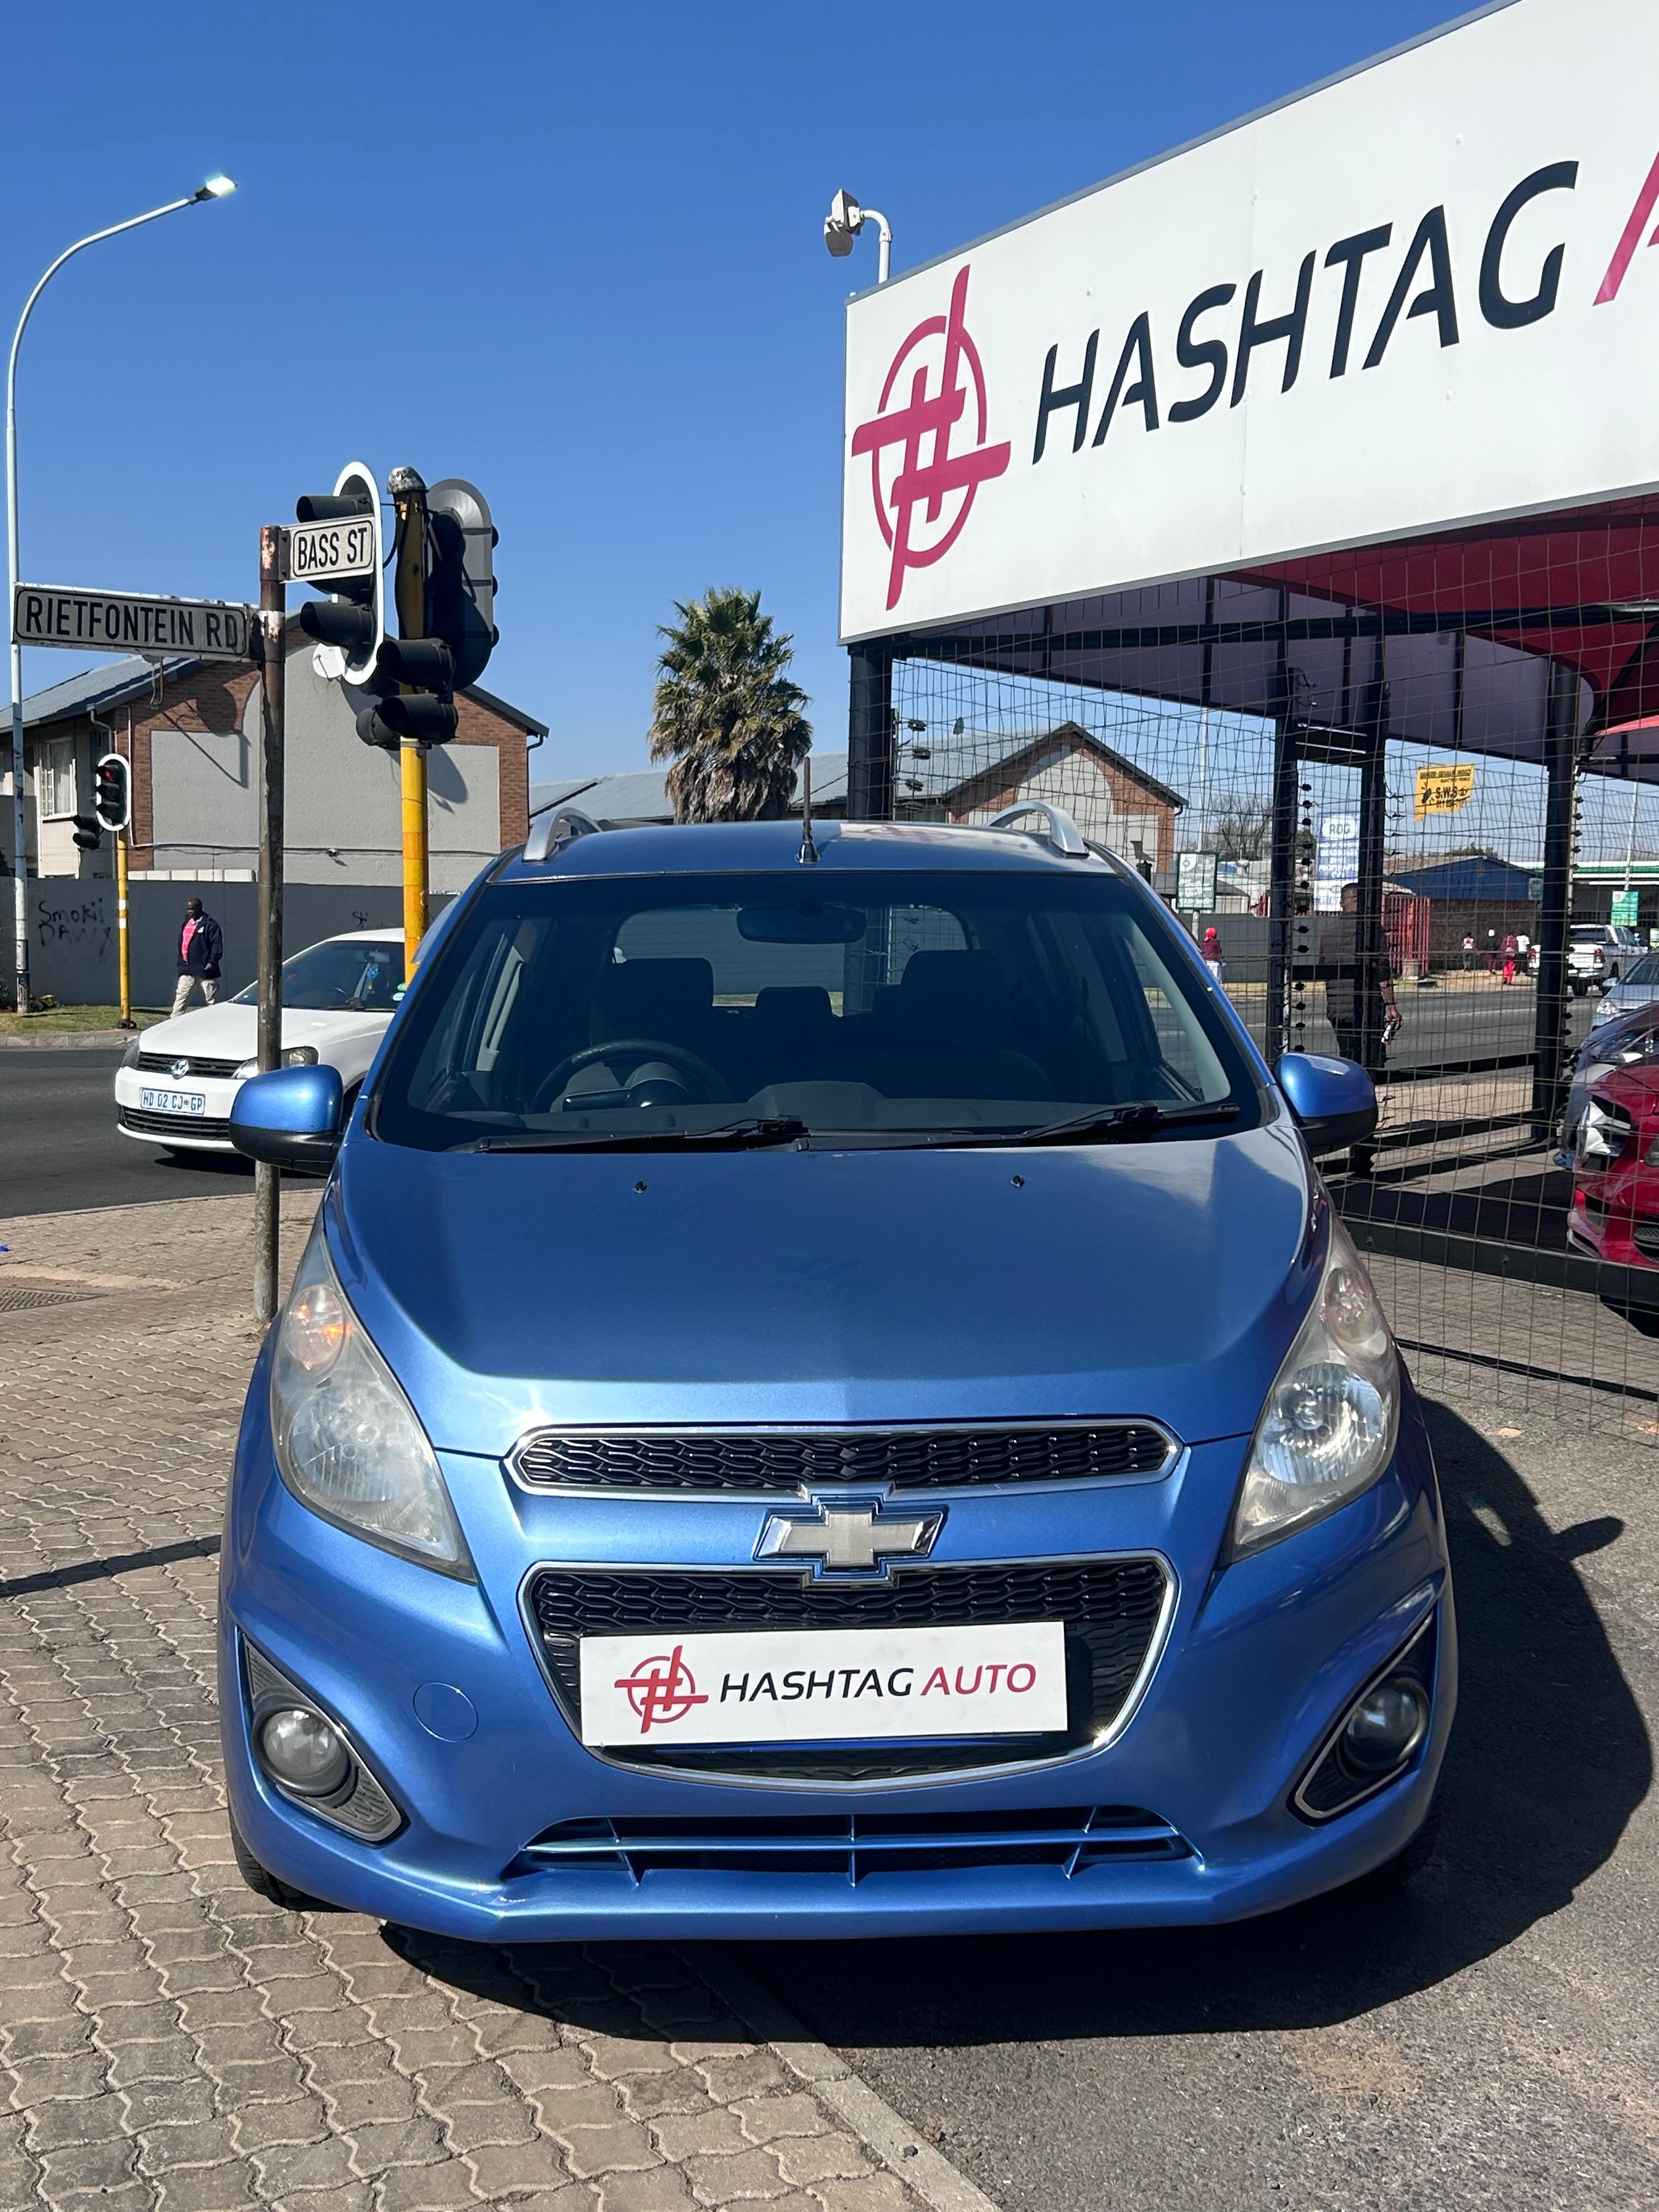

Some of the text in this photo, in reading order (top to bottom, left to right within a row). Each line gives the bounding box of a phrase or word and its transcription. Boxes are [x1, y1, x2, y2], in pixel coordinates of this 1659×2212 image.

[1031, 160, 1579, 466] HASHTAG
[298, 527, 368, 571] BASS ST
[26, 595, 238, 649] RIETFONTEIN RD
[1330, 823, 1351, 834] RDG
[143, 1091, 202, 1111] HD 02 CJ GP
[720, 1663, 1037, 1703] HASHTAG AUTO
